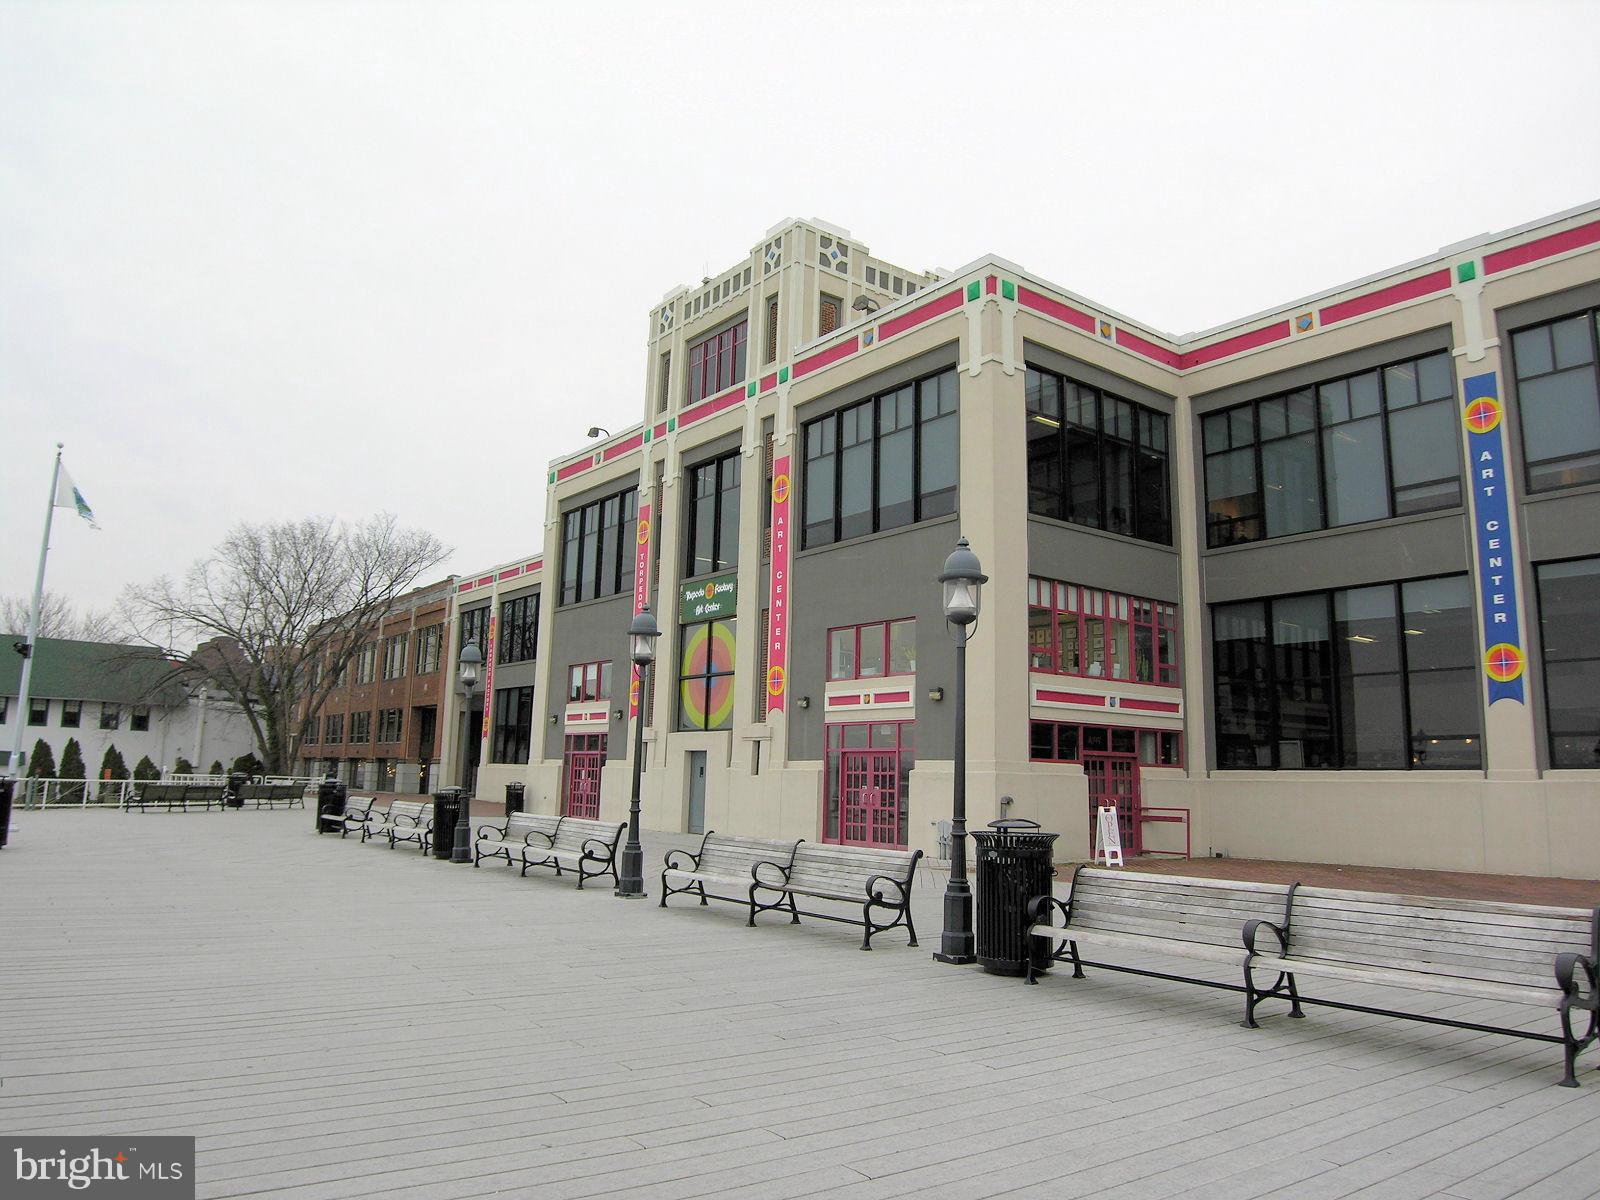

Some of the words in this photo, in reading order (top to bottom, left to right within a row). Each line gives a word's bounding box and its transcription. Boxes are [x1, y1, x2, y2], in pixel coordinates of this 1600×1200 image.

[1480, 451, 1494, 497] ART
[637, 553, 645, 609] TORPEDO
[1486, 520, 1507, 623] CENTER
[774, 570, 783, 650] CENTER
